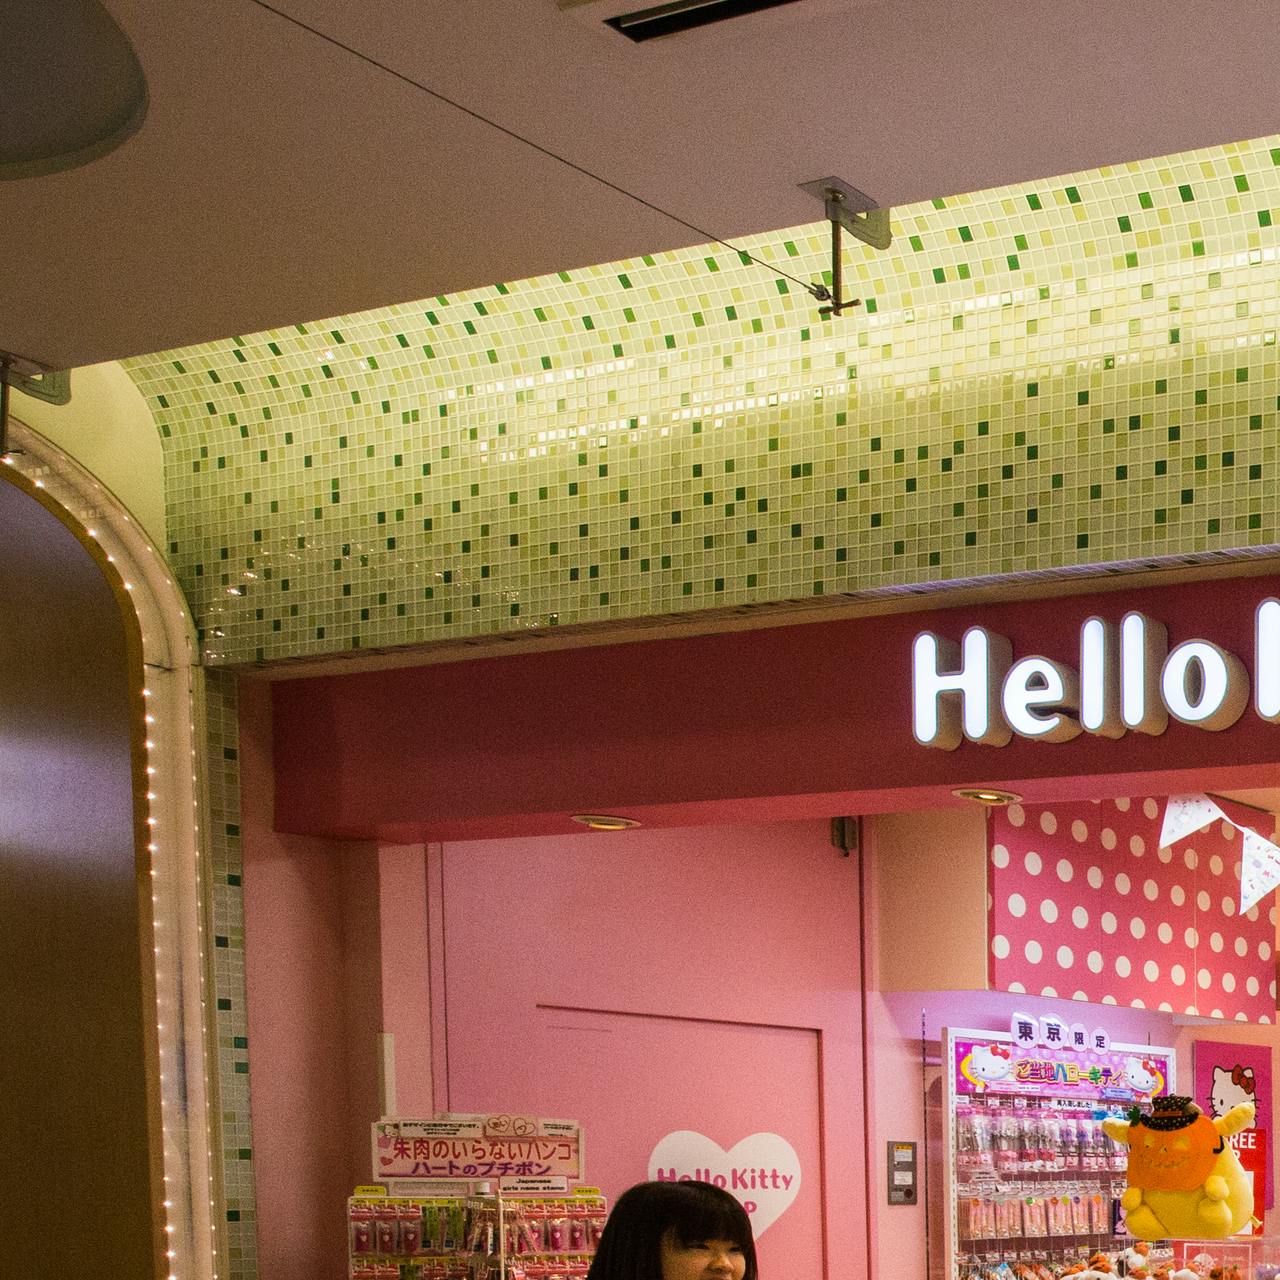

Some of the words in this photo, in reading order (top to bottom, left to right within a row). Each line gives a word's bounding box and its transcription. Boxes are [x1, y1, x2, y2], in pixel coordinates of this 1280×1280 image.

[1018, 1021, 1105, 1048] 東京限定
[1016, 1057, 1125, 1087] ご当地ハローキティ
[393, 1139, 572, 1161] 朱肉のいらないハンコ
[411, 1161, 552, 1176] ハートのプチポン
[731, 1168, 793, 1190] Kitty
